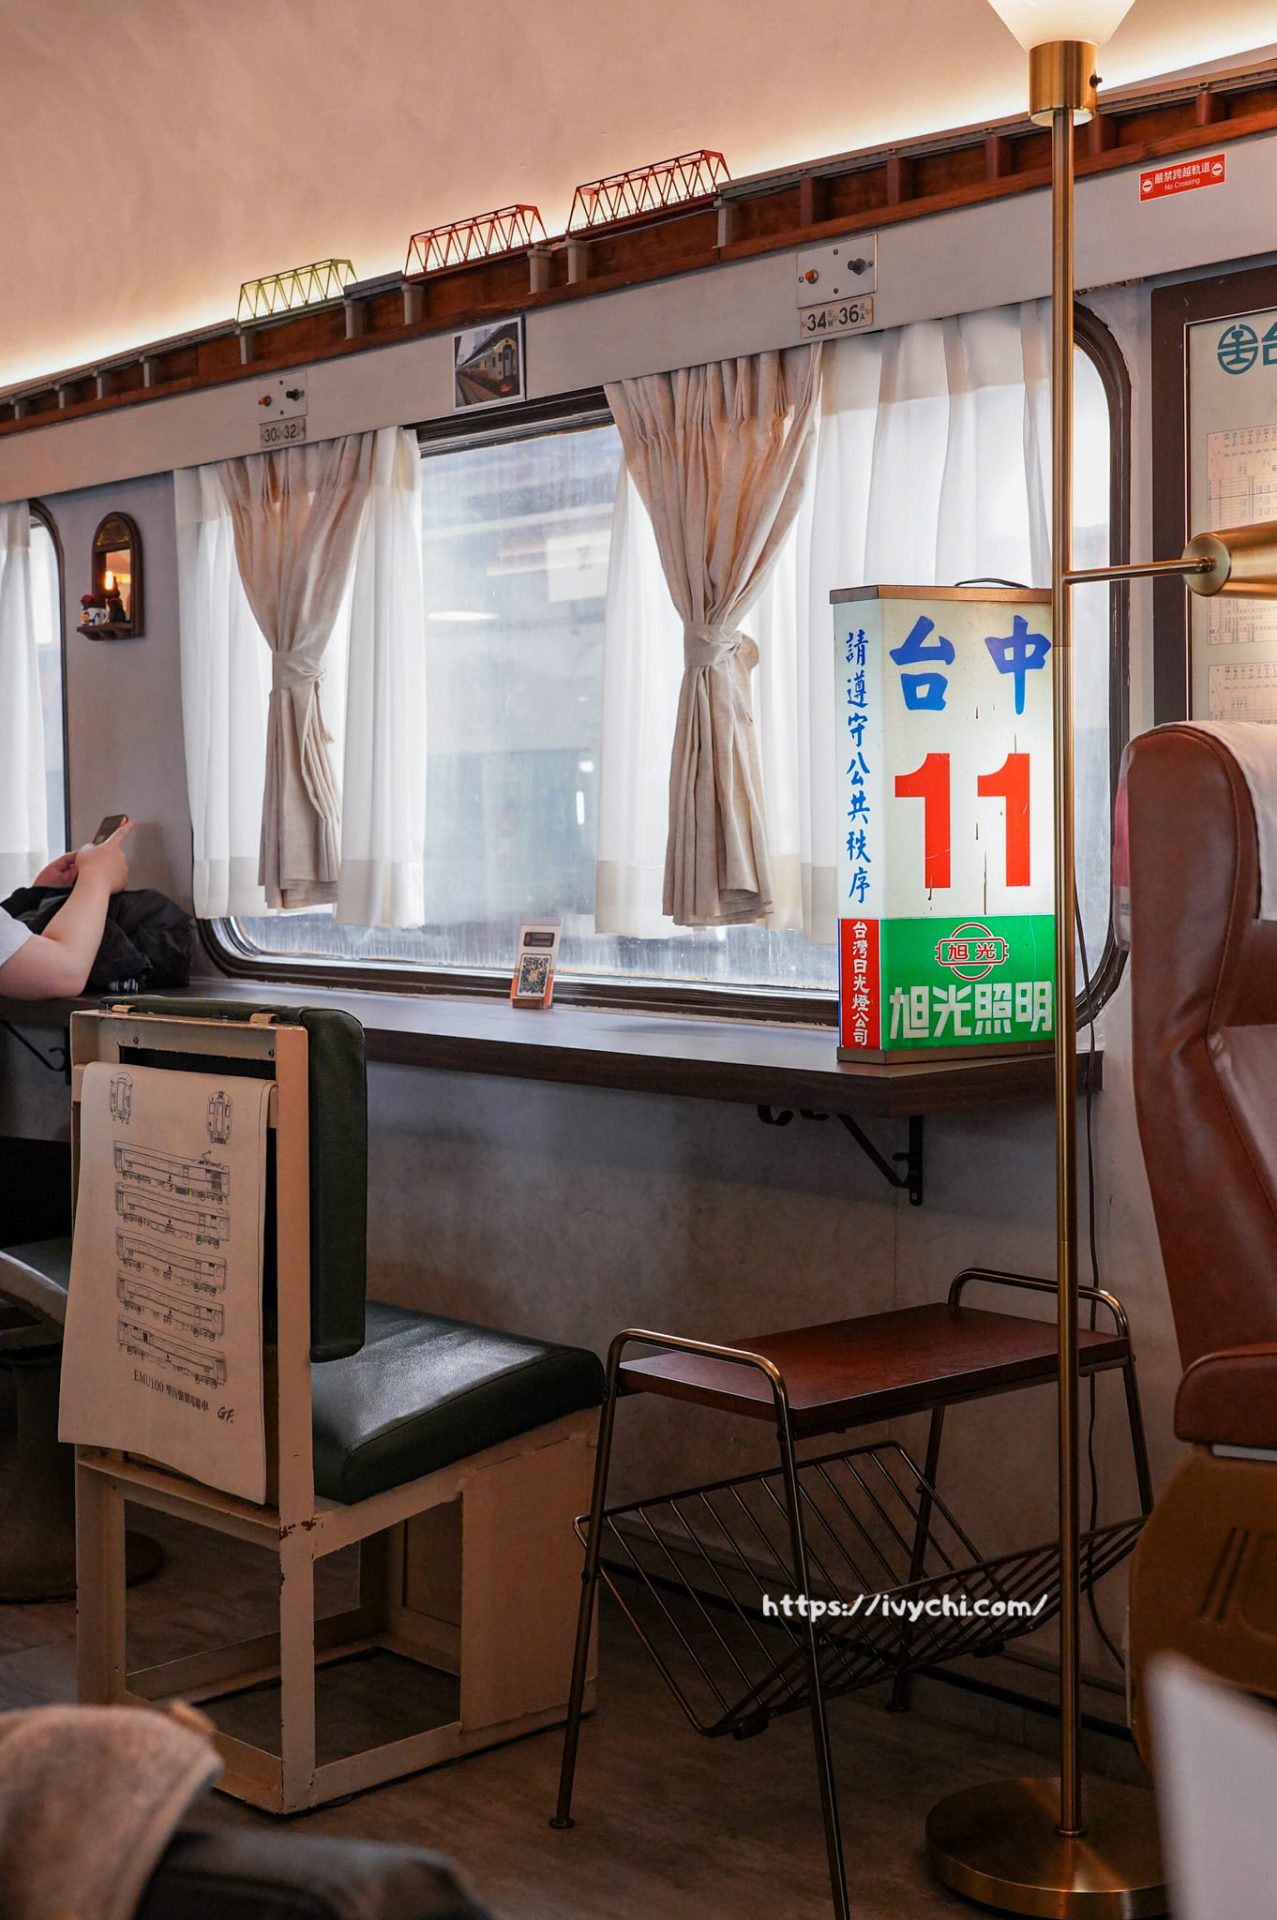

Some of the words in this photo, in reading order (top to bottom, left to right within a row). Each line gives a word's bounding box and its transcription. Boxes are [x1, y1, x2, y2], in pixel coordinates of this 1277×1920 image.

[1164, 183, 1173, 191] No
[1174, 178, 1201, 189] Crossing
[807, 311, 827, 331] 34
[838, 304, 859, 325] 36
[264, 427, 277, 442] 30
[283, 423, 297, 439] 32
[889, 614, 1053, 715] 台中
[845, 630, 872, 905] 請遵守公共秩序
[895, 752, 1031, 889] 11
[947, 943, 996, 961] 旭光
[851, 921, 870, 1046] 台灣日光燈公司
[889, 981, 1053, 1040] 旭光照明
[133, 1369, 164, 1393] EMU100
